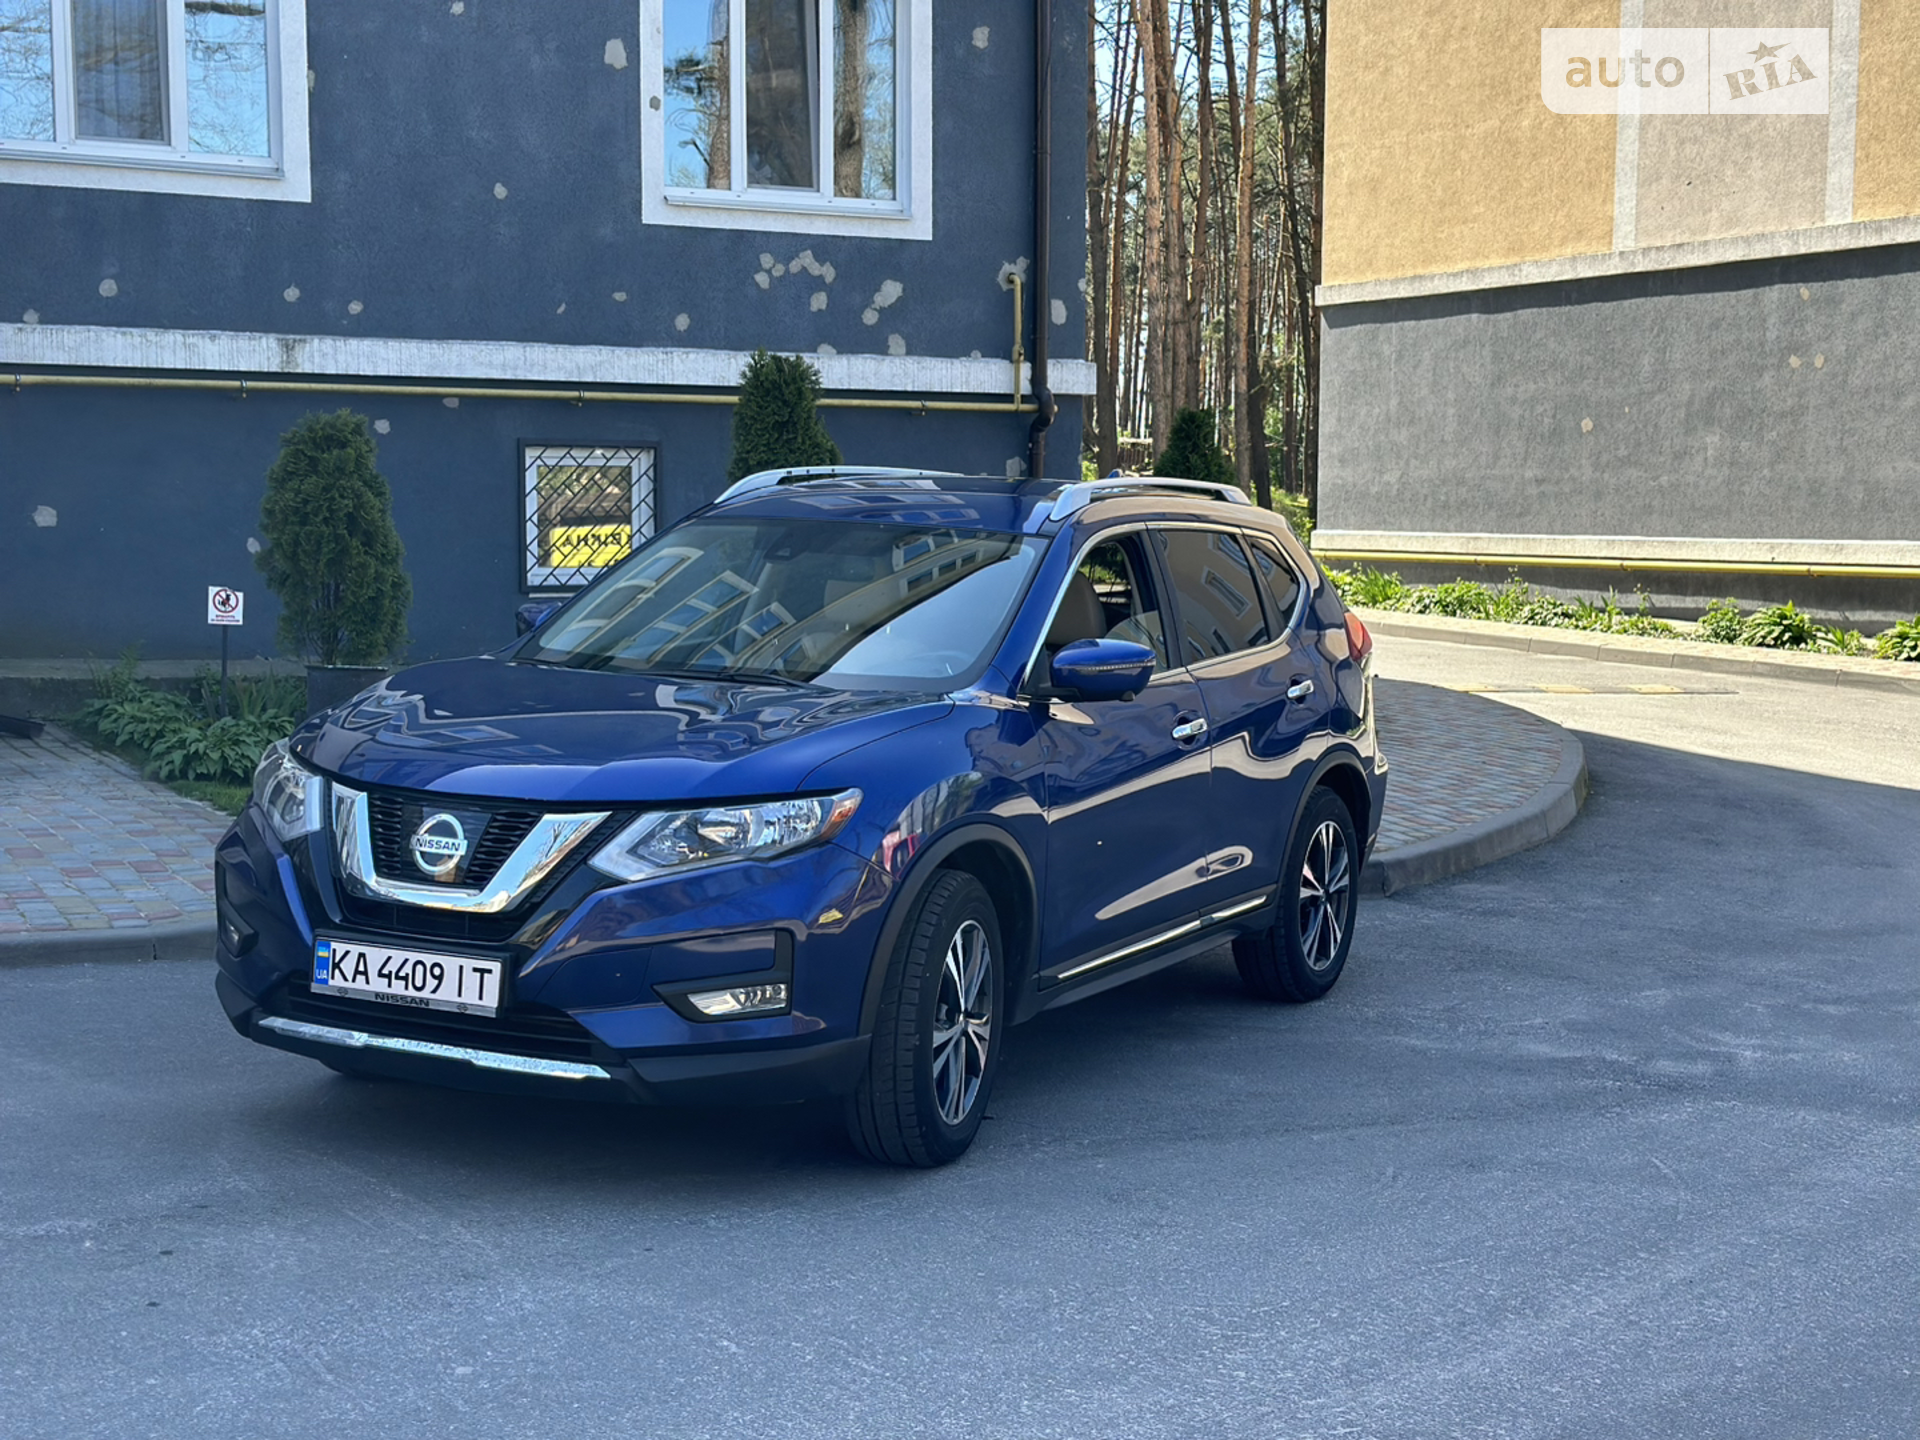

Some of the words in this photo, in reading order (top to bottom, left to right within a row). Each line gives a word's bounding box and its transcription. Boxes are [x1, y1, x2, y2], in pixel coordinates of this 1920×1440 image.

[415, 837, 461, 852] NISSAN
[315, 969, 328, 980] UA
[331, 948, 370, 985] KA
[377, 955, 445, 994] 4409
[457, 964, 493, 1001] IT
[374, 992, 430, 1008] NISSAN
